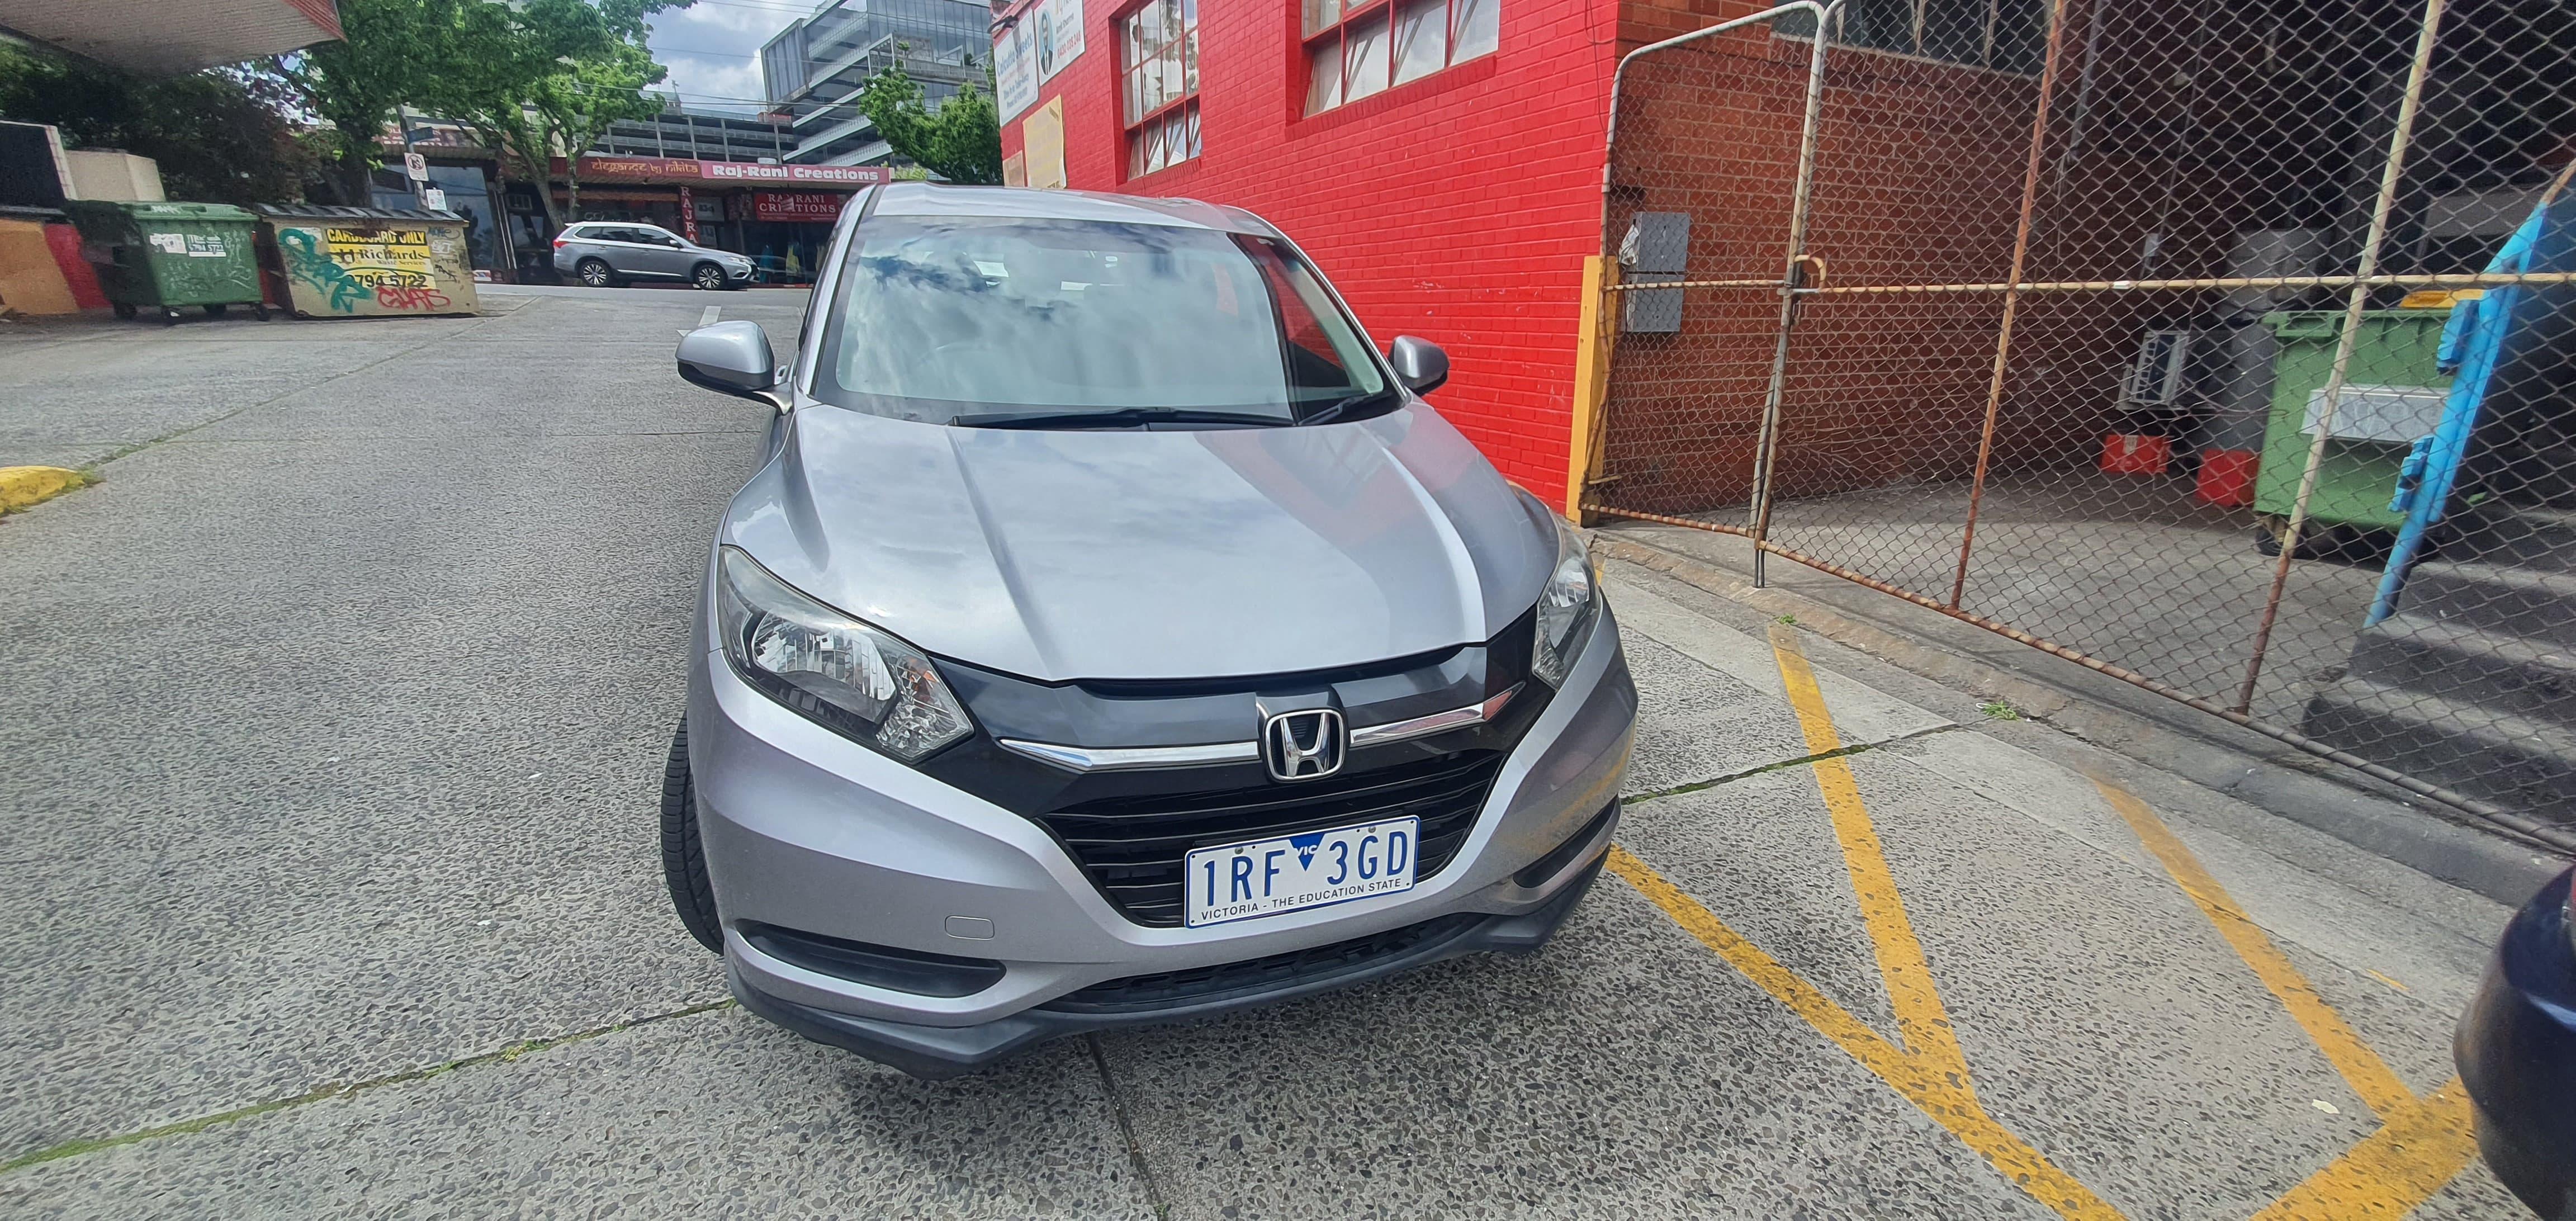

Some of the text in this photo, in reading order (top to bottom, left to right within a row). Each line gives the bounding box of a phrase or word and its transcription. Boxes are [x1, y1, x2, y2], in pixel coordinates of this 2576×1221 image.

[650, 163, 662, 174] by
[666, 161, 698, 173] nikita
[712, 164, 878, 181] Raj-Rani Creations
[359, 248, 424, 260] Richards
[1296, 844, 1318, 856] VIC
[1204, 831, 1408, 907] 1RF 3GD
[1201, 904, 1258, 921] VICTORIA
[1272, 898, 1295, 908] THE
[1299, 886, 1364, 904] EDUCATION
[1368, 878, 1401, 892] STATE
